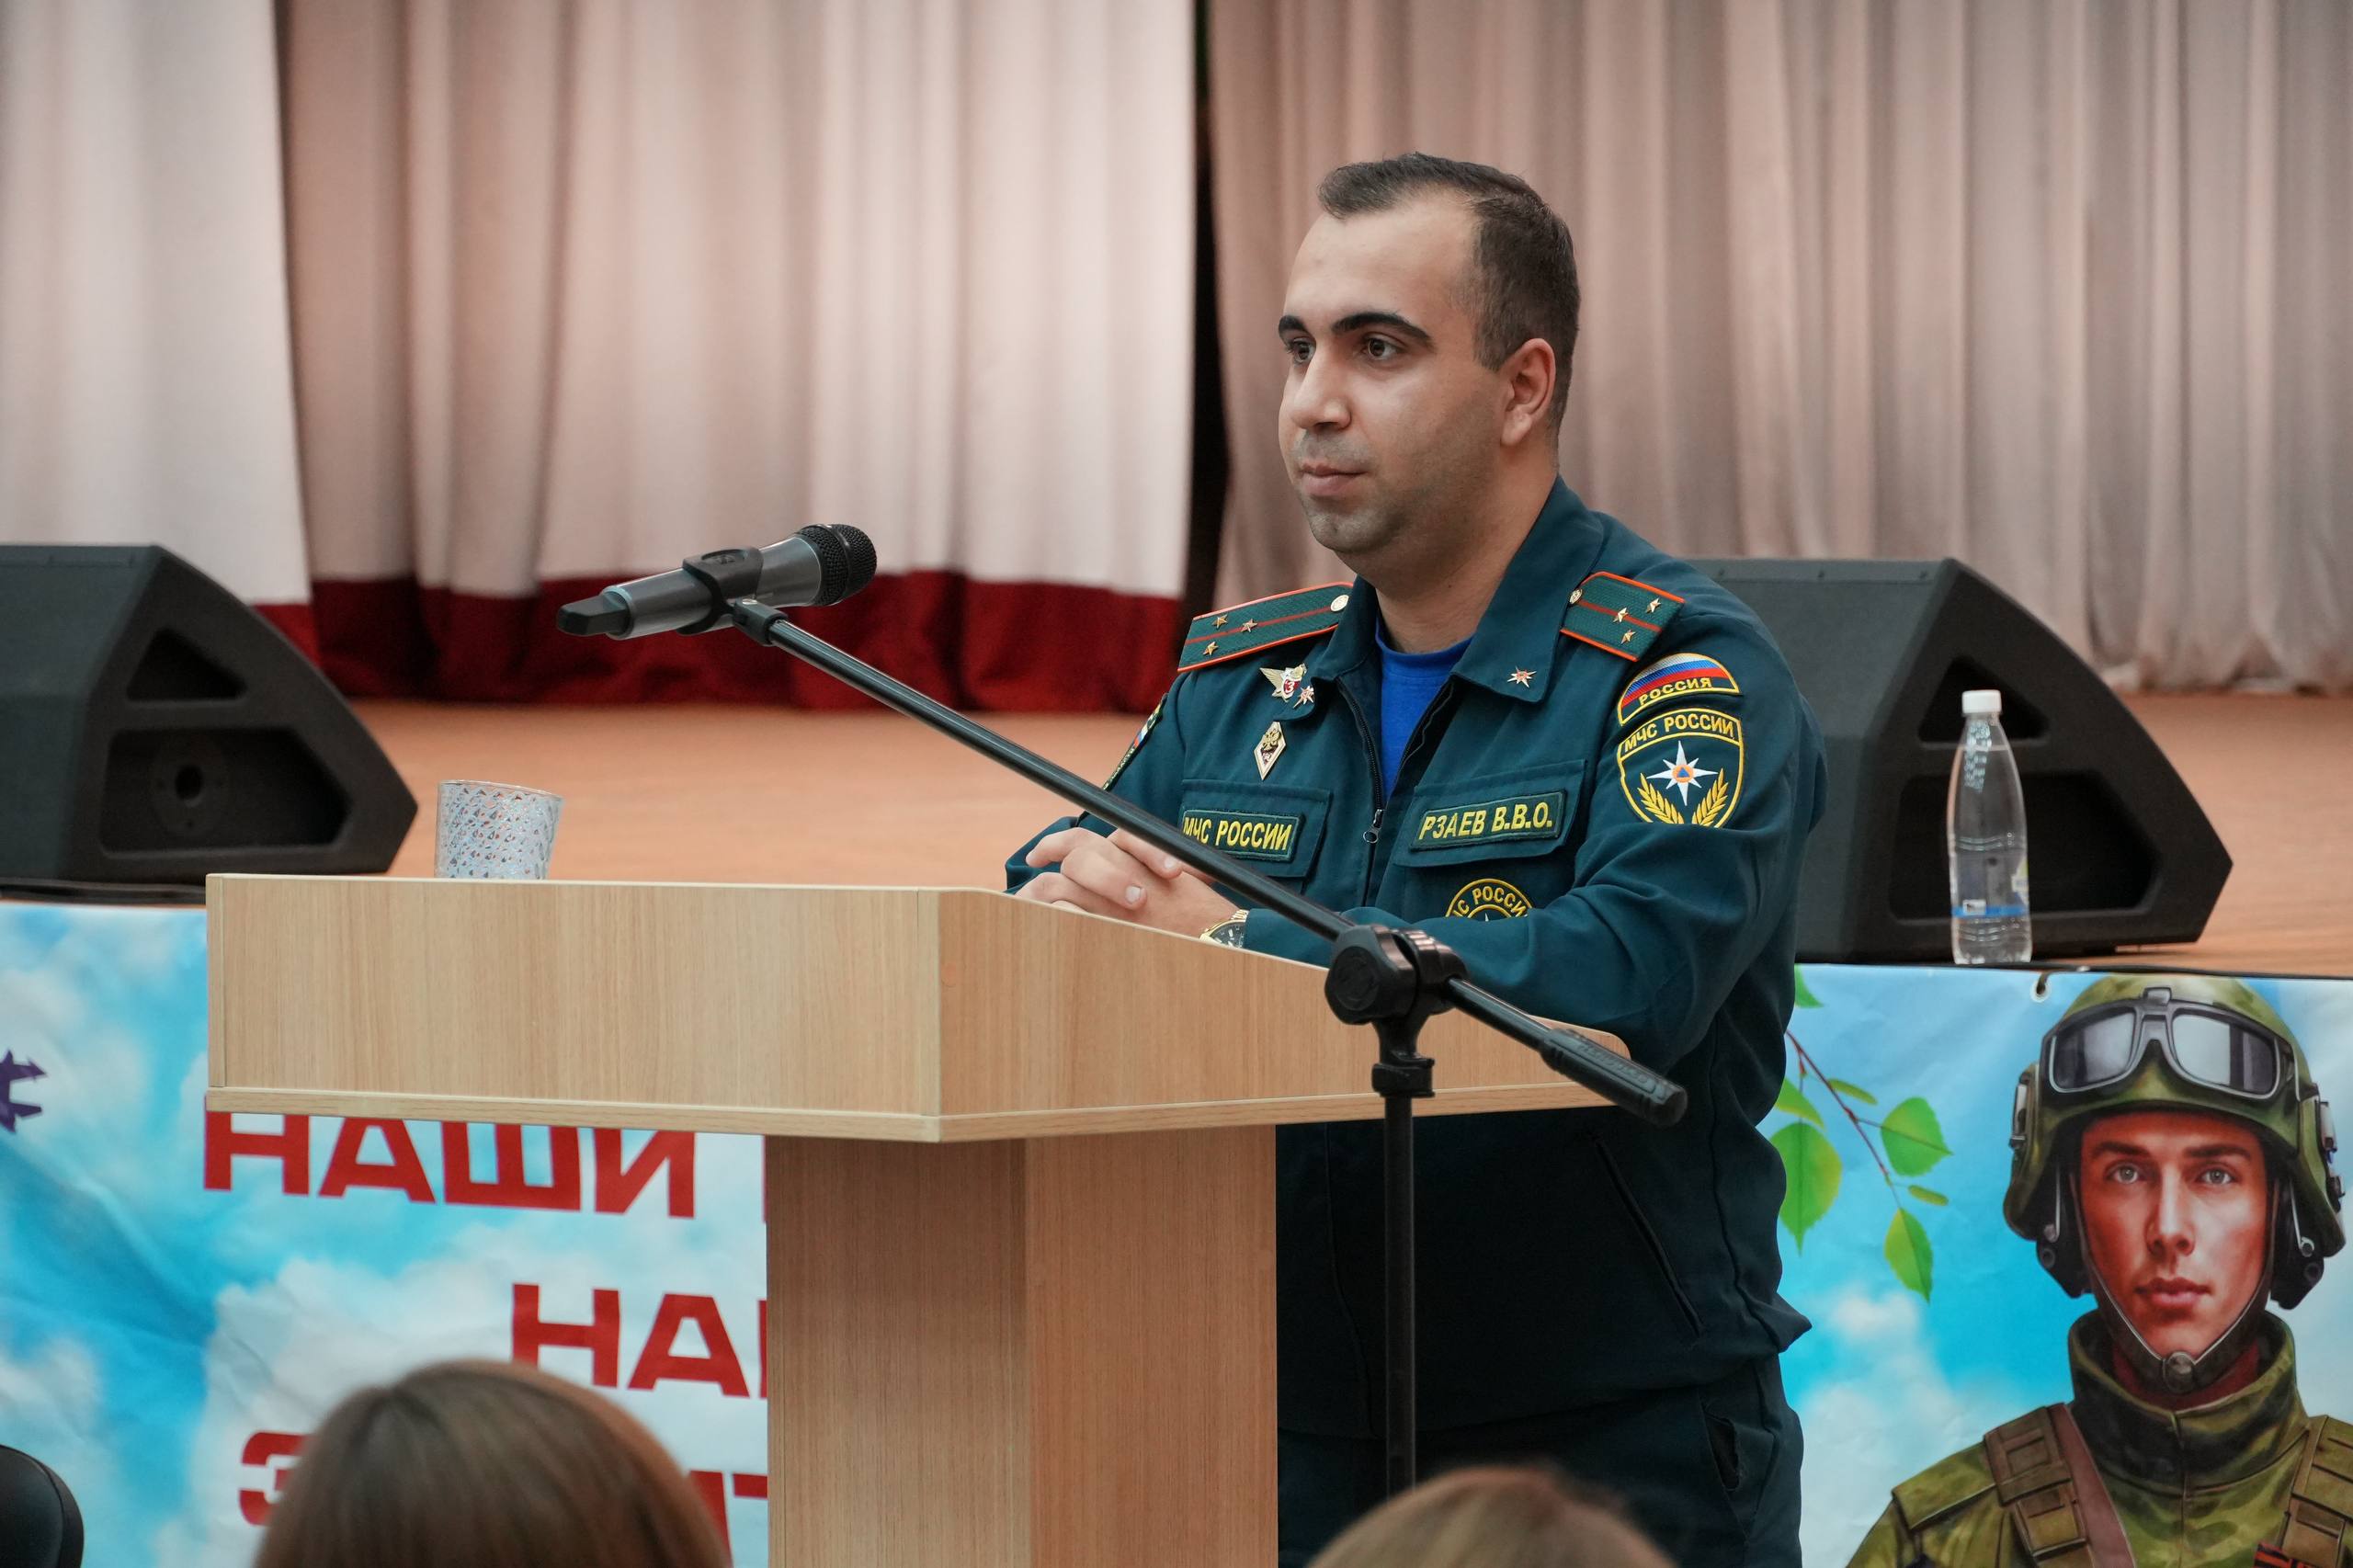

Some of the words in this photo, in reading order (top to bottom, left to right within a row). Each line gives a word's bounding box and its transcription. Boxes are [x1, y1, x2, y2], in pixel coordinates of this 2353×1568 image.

[1637, 677, 1713, 706] РОССИЯ
[1623, 723, 1658, 753] МЧС
[1664, 713, 1734, 739] РОССИИ
[1183, 816, 1212, 844] МЧС
[1215, 820, 1292, 850] РОССИИ
[1418, 810, 1487, 840] РЗАЕВ
[1491, 801, 1553, 833] В.В.О.
[1472, 886, 1529, 917] РОССИ
[204, 1103, 696, 1219] НАШИ
[511, 1283, 767, 1400] НА
